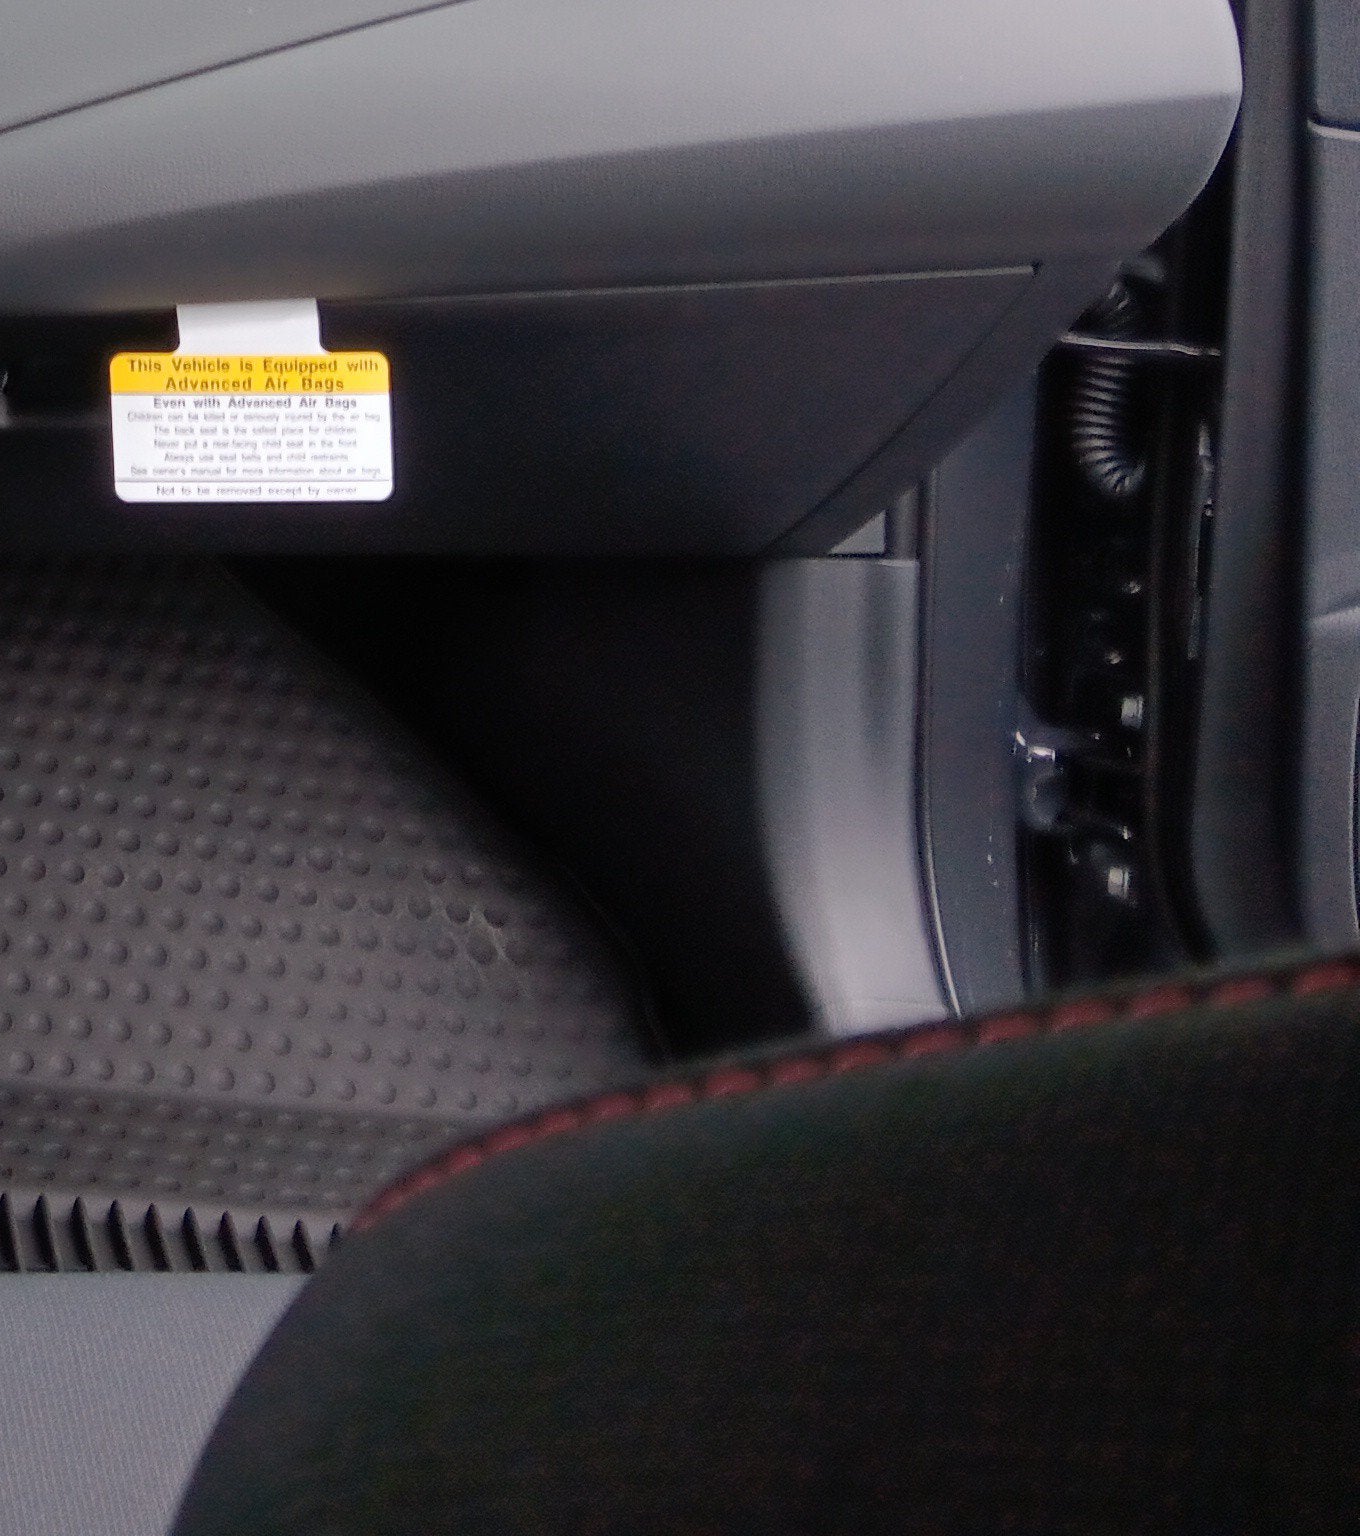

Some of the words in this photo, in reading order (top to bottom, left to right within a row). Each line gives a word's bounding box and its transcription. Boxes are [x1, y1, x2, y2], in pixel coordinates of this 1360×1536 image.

[128, 357, 162, 373] This
[171, 357, 231, 373] Vehicle
[240, 357, 254, 373] is
[263, 357, 339, 376] Equipped
[347, 358, 379, 373] with
[165, 376, 253, 392] Advanced
[265, 376, 288, 392] Air
[301, 376, 345, 393] Bags
[153, 397, 186, 409] Even
[193, 397, 221, 409] with
[228, 396, 292, 409] Advanced
[299, 397, 317, 409] Air
[325, 397, 357, 410] Bags
